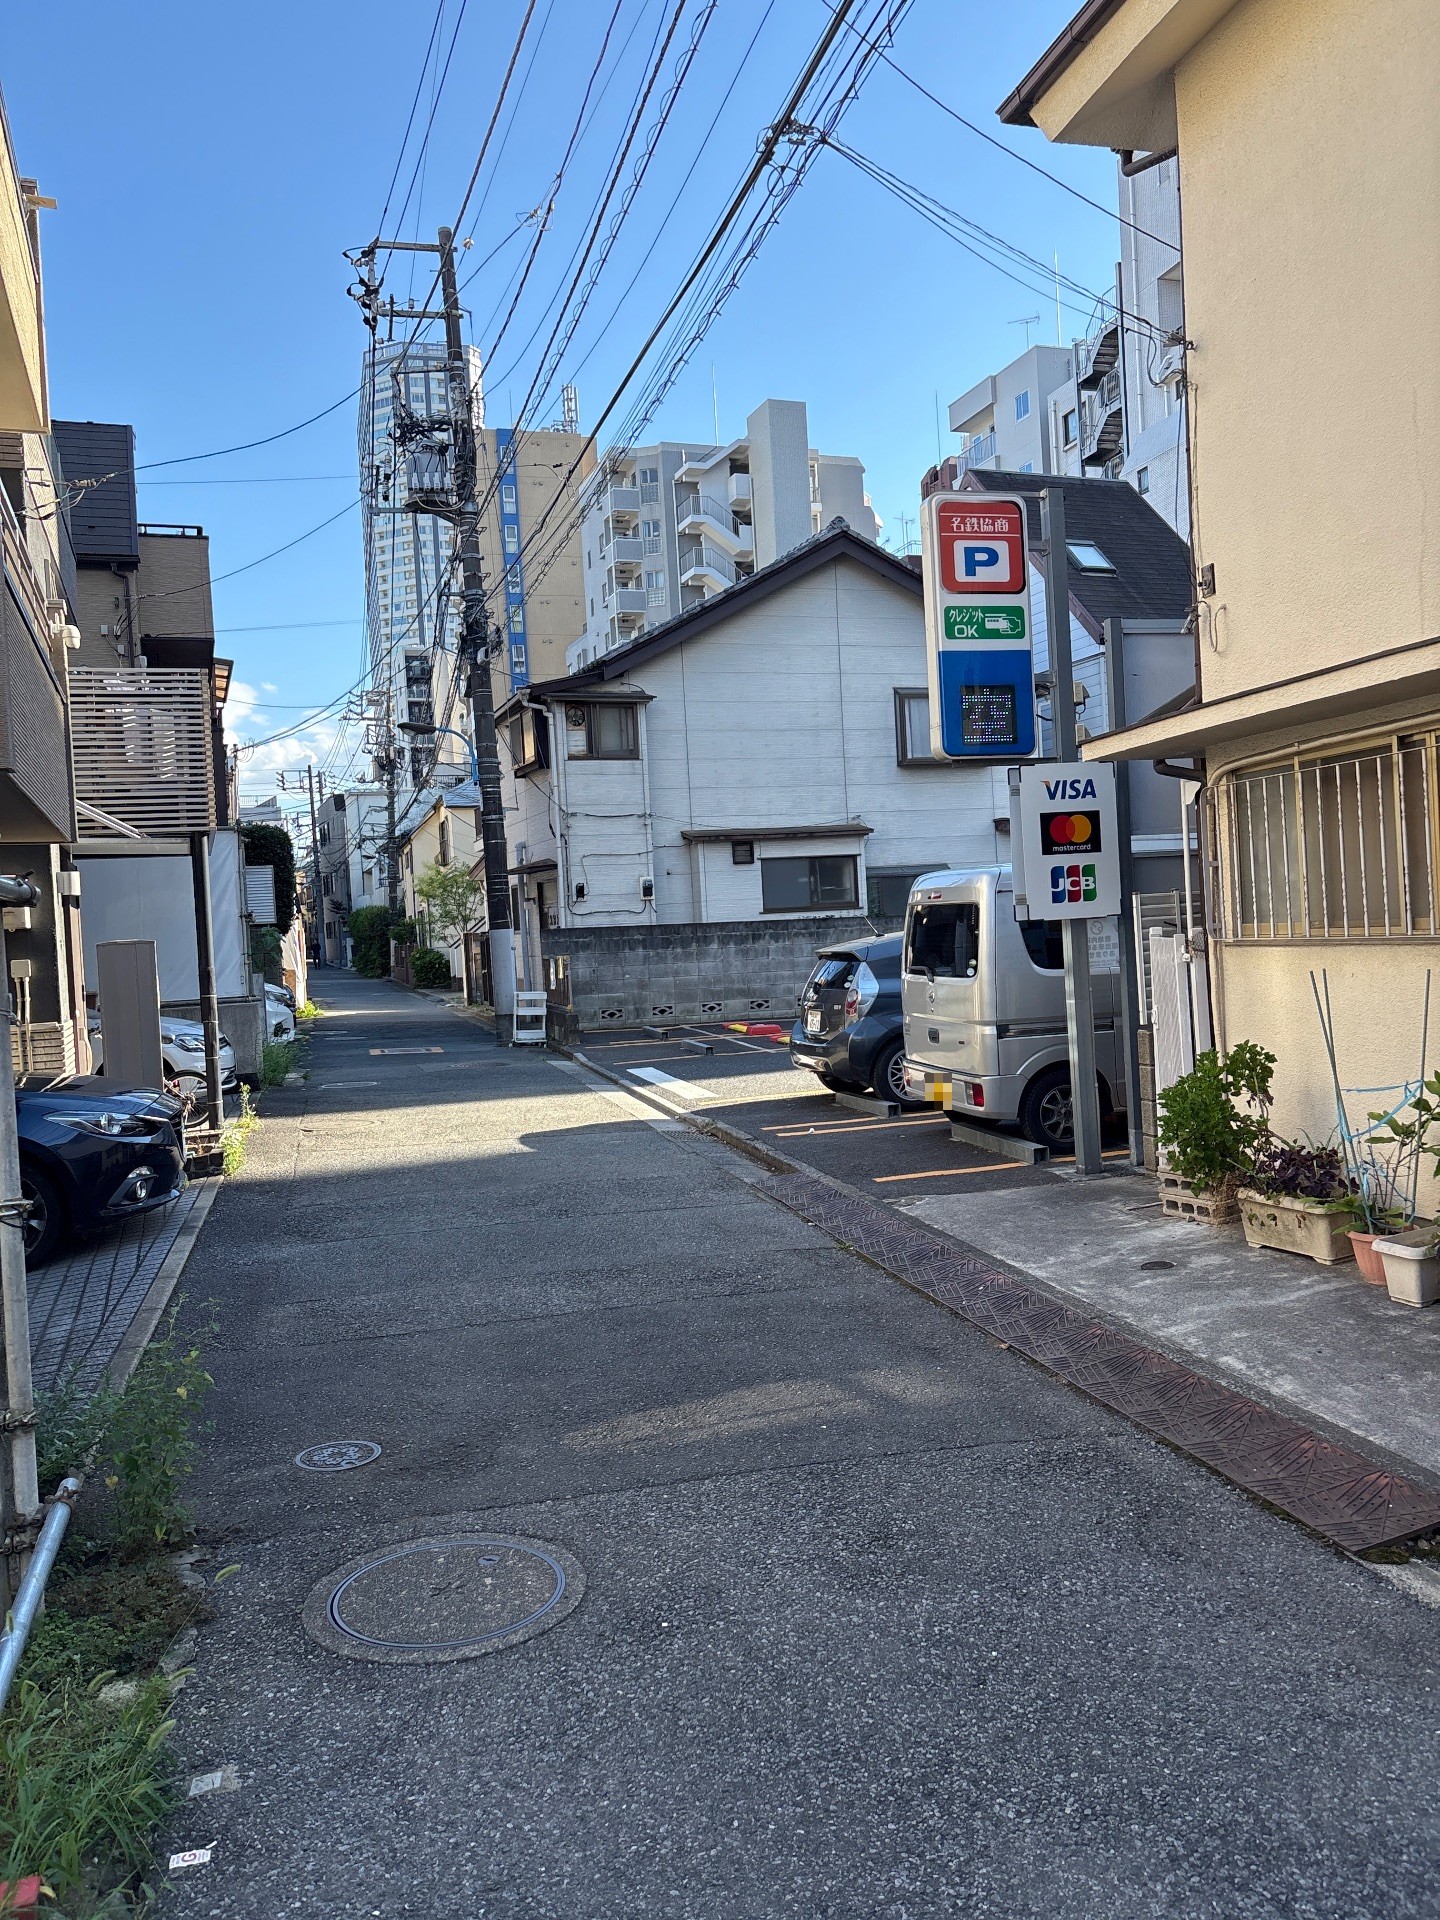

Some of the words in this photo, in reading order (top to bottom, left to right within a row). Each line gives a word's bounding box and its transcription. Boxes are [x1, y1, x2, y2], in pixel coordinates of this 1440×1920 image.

[951, 517, 1009, 532] 名鉄協商
[964, 547, 999, 576] P
[949, 608, 984, 623] クレジット
[954, 624, 979, 638] OK
[1040, 778, 1097, 800] VISA
[1052, 843, 1091, 852] mastercard
[1050, 876, 1096, 892] JCB
